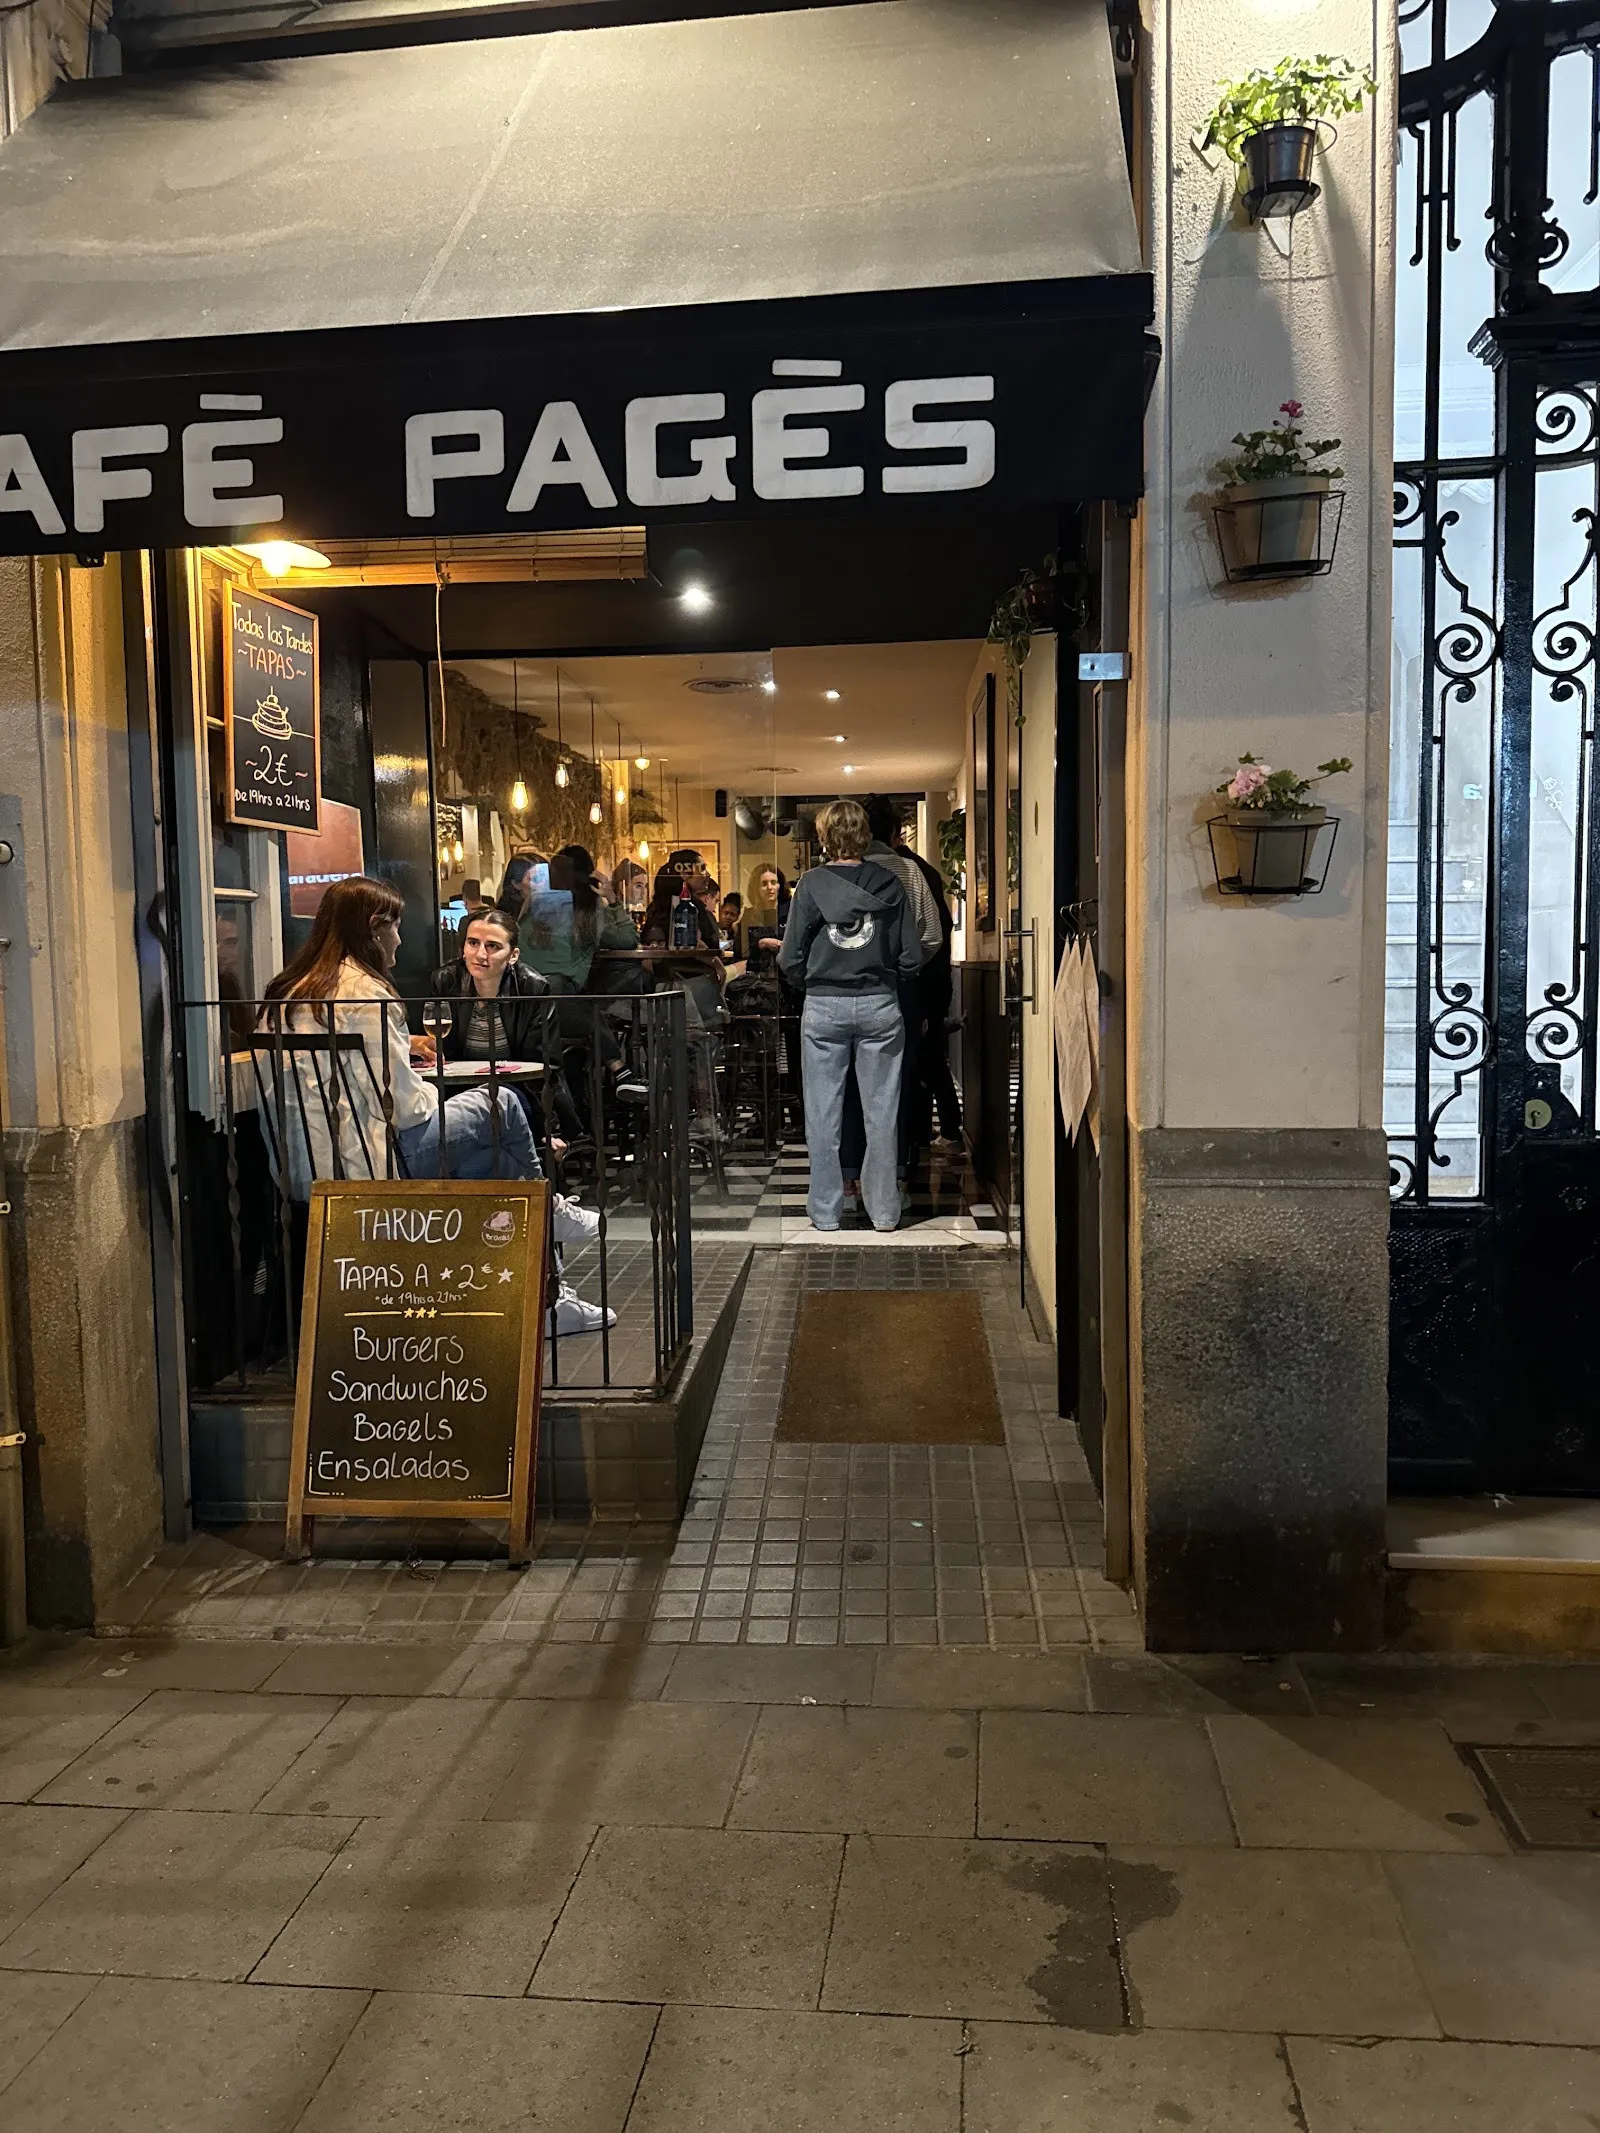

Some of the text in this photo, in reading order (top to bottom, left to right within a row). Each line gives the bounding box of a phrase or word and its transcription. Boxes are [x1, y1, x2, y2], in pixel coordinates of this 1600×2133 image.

[231, 601, 313, 655] Todas las Tardes
[243, 641, 295, 680] TAPAS
[253, 745, 293, 786] 2€
[235, 788, 247, 801] De
[276, 796, 283, 806] a
[284, 794, 311, 812] 21hrs
[353, 1208, 462, 1243] TARDEO
[333, 1258, 404, 1291] TAPAS
[415, 1263, 429, 1288] A
[328, 1370, 488, 1402] Sandwiches
[353, 1412, 453, 1442] Bagels
[317, 1450, 470, 1481] Ensaladas
